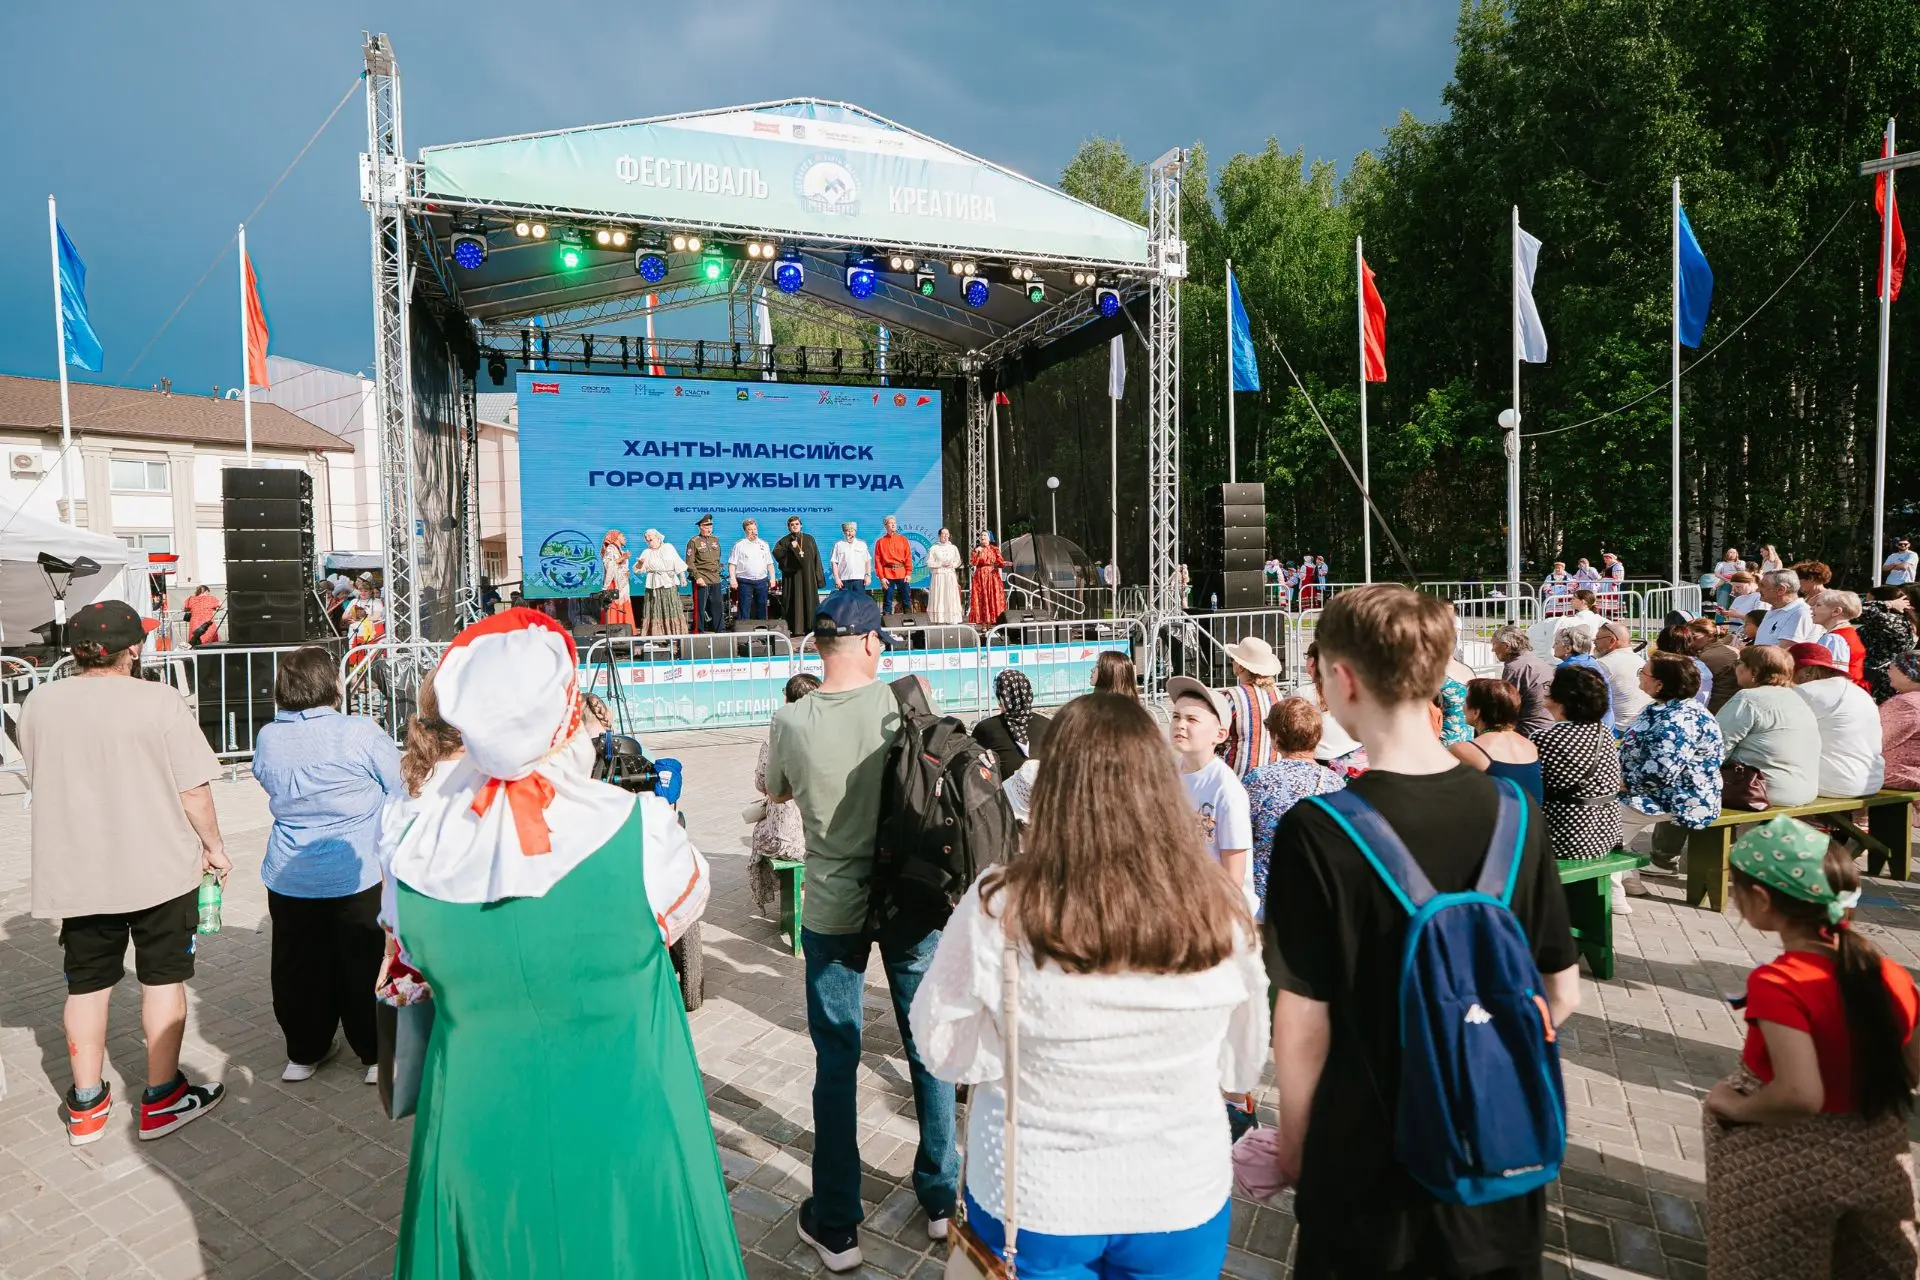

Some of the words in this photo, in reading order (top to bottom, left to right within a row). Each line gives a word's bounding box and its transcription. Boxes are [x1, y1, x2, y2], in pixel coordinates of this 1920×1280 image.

[615, 154, 769, 199] ФЕСТИВАЛЬ
[889, 185, 997, 222] КРЕАТИВА
[622, 440, 874, 461] ХАНТЫ-МАНСИЙСК
[588, 470, 684, 490] ГОРОД
[688, 472, 799, 490] ДРУЖБЫ
[804, 473, 820, 488] И
[824, 474, 904, 491] ТРУДА
[727, 506, 797, 514] НАЦИОНАЛЬНЫХ
